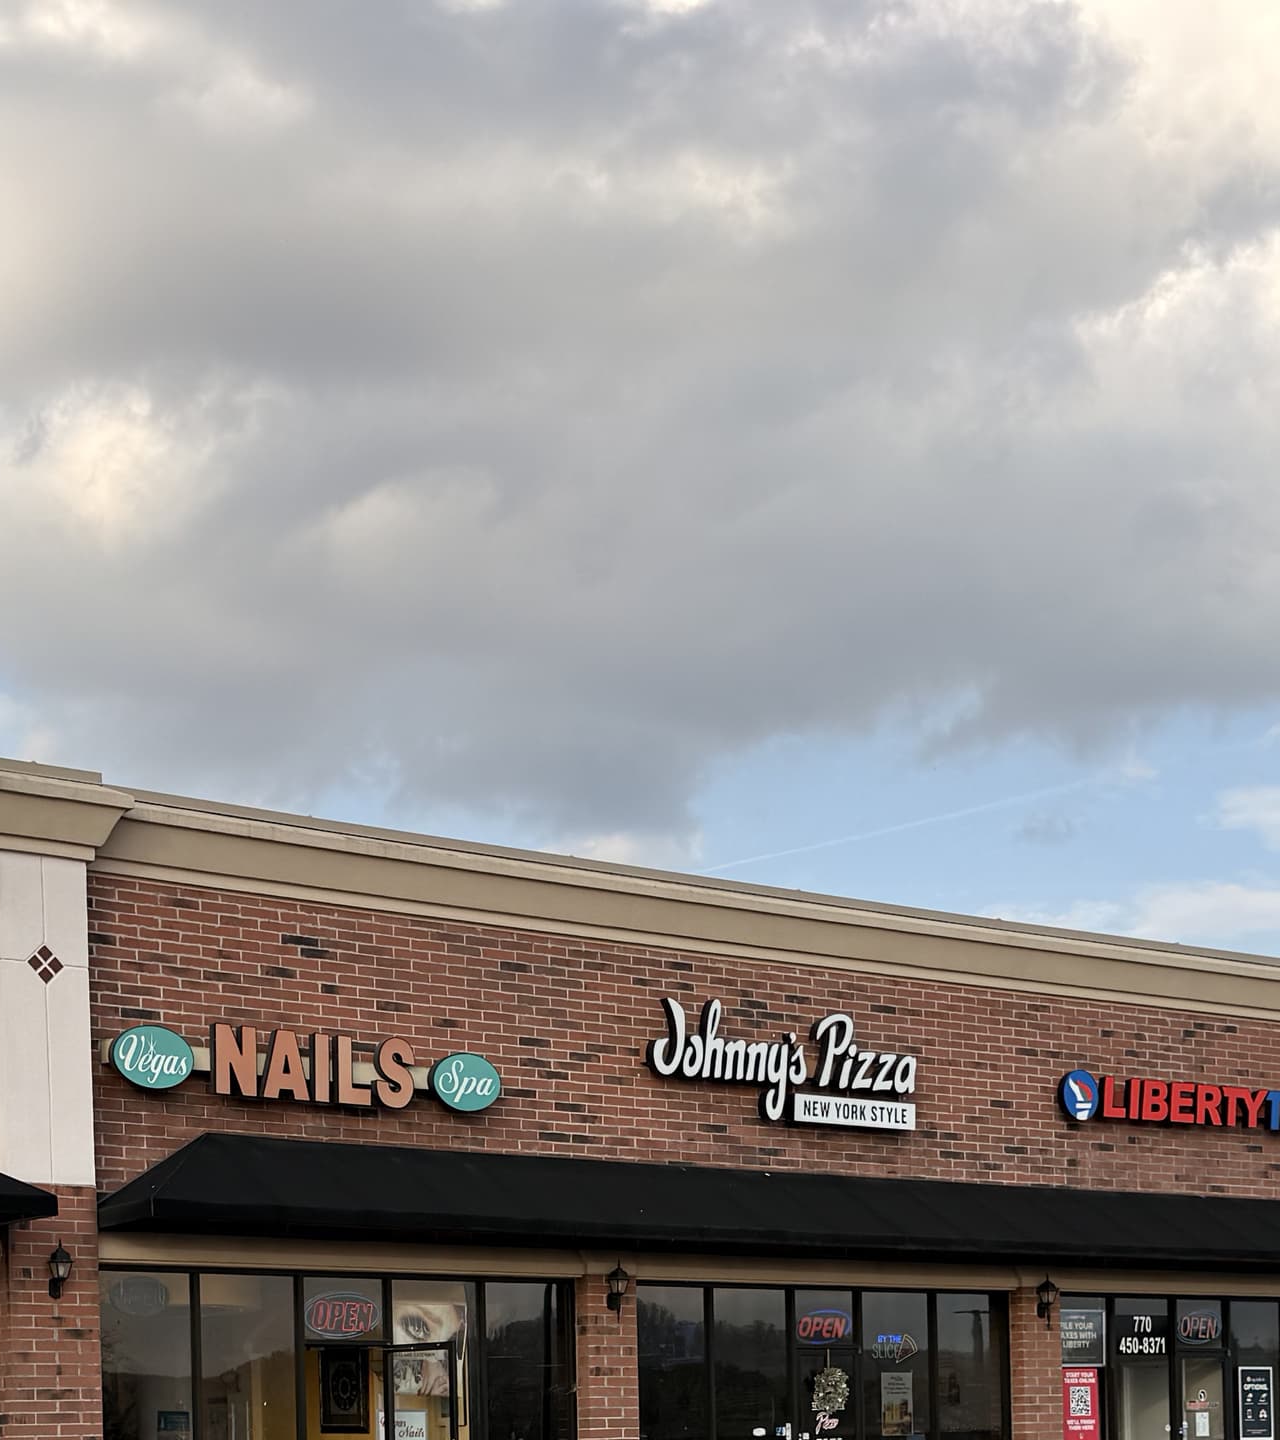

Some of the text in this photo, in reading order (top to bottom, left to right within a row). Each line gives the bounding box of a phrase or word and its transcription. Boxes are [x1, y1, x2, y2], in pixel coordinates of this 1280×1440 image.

[118, 1033, 188, 1084] Vegas
[211, 1022, 416, 1110] NAILS
[650, 997, 918, 1121] Johnny's Pizza
[437, 1060, 495, 1103] Spa
[803, 1100, 908, 1125] NEW YORK STYLE
[311, 1300, 374, 1332] OPEN
[798, 1316, 846, 1340] OPEN
[1133, 1316, 1152, 1333] 770
[1180, 1316, 1217, 1339] OPEN
